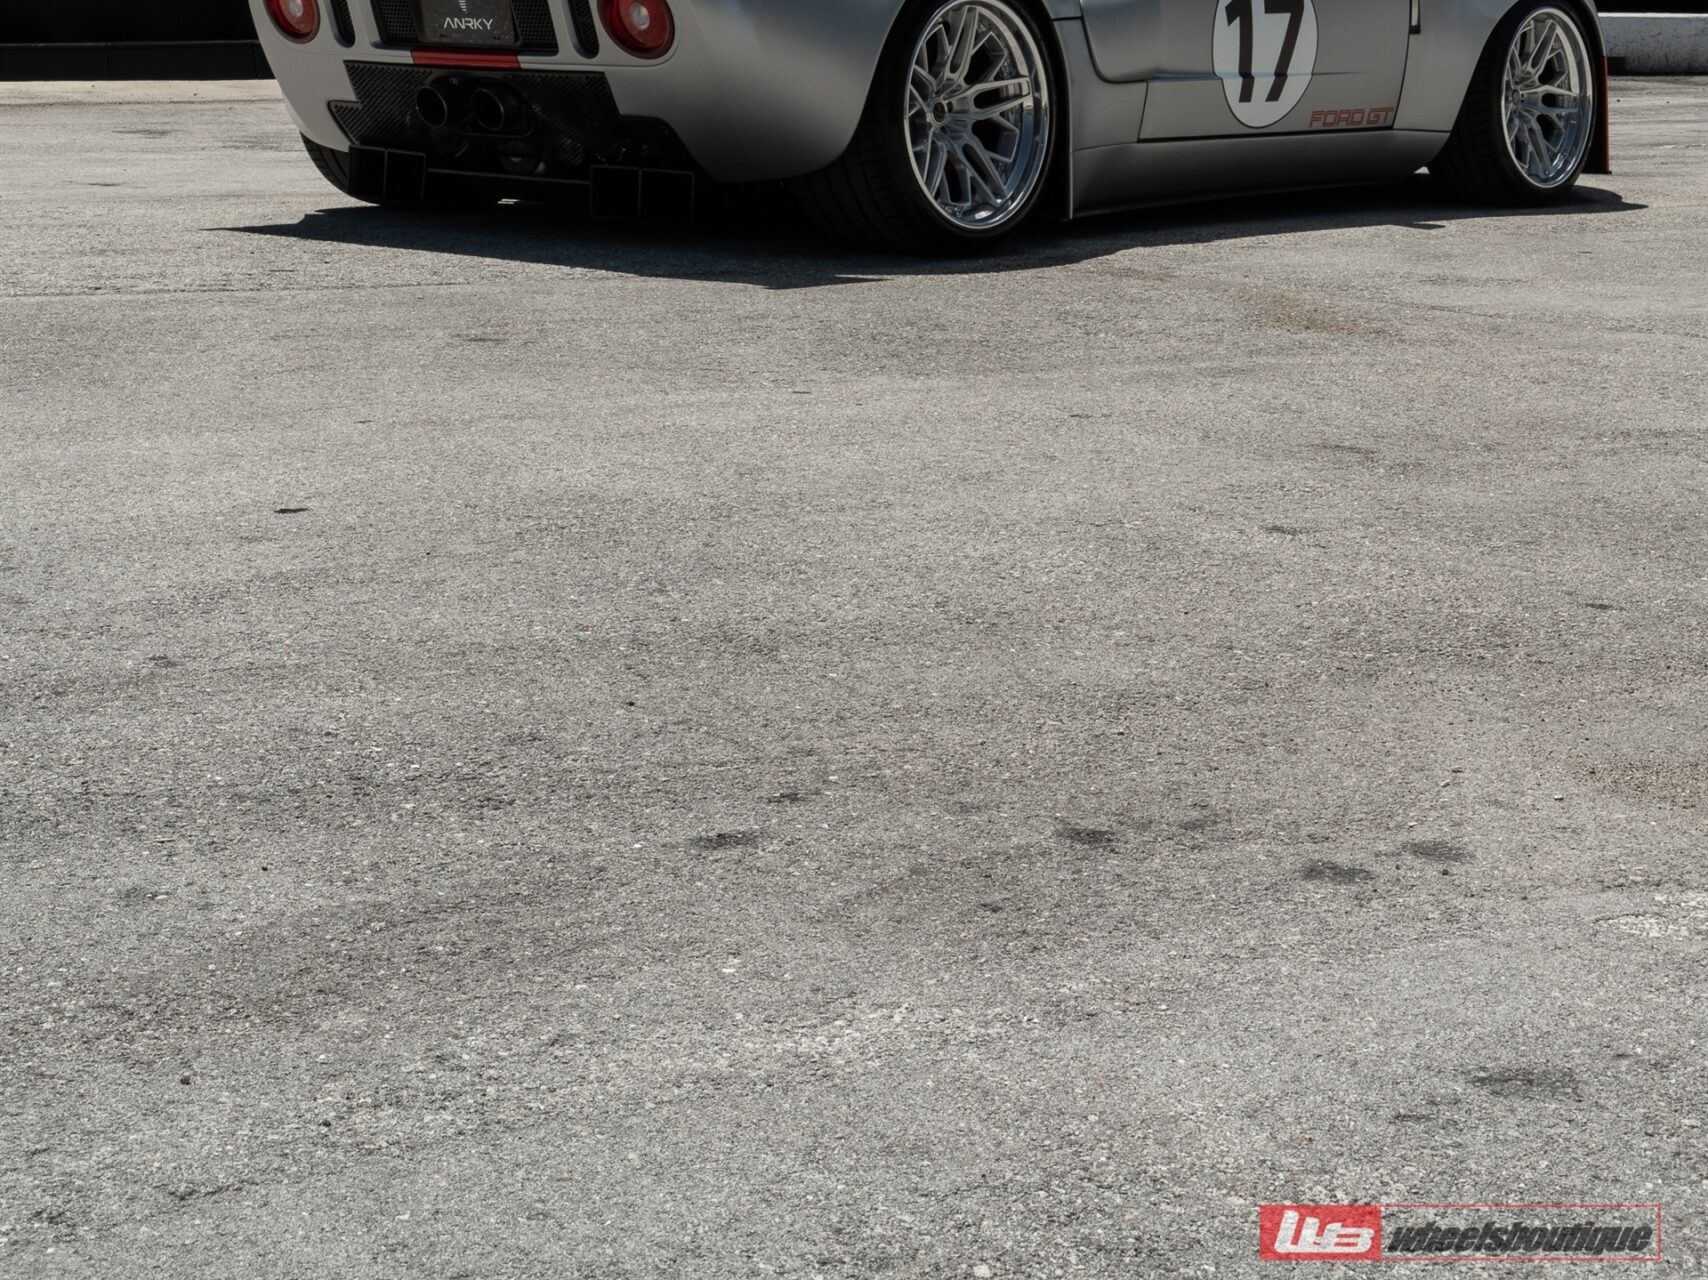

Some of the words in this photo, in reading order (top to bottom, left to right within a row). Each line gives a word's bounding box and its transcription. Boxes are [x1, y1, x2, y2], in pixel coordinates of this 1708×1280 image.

[443, 17, 494, 31] ANRKY
[1309, 108, 1366, 128] FORD
[1366, 106, 1394, 125] GT
